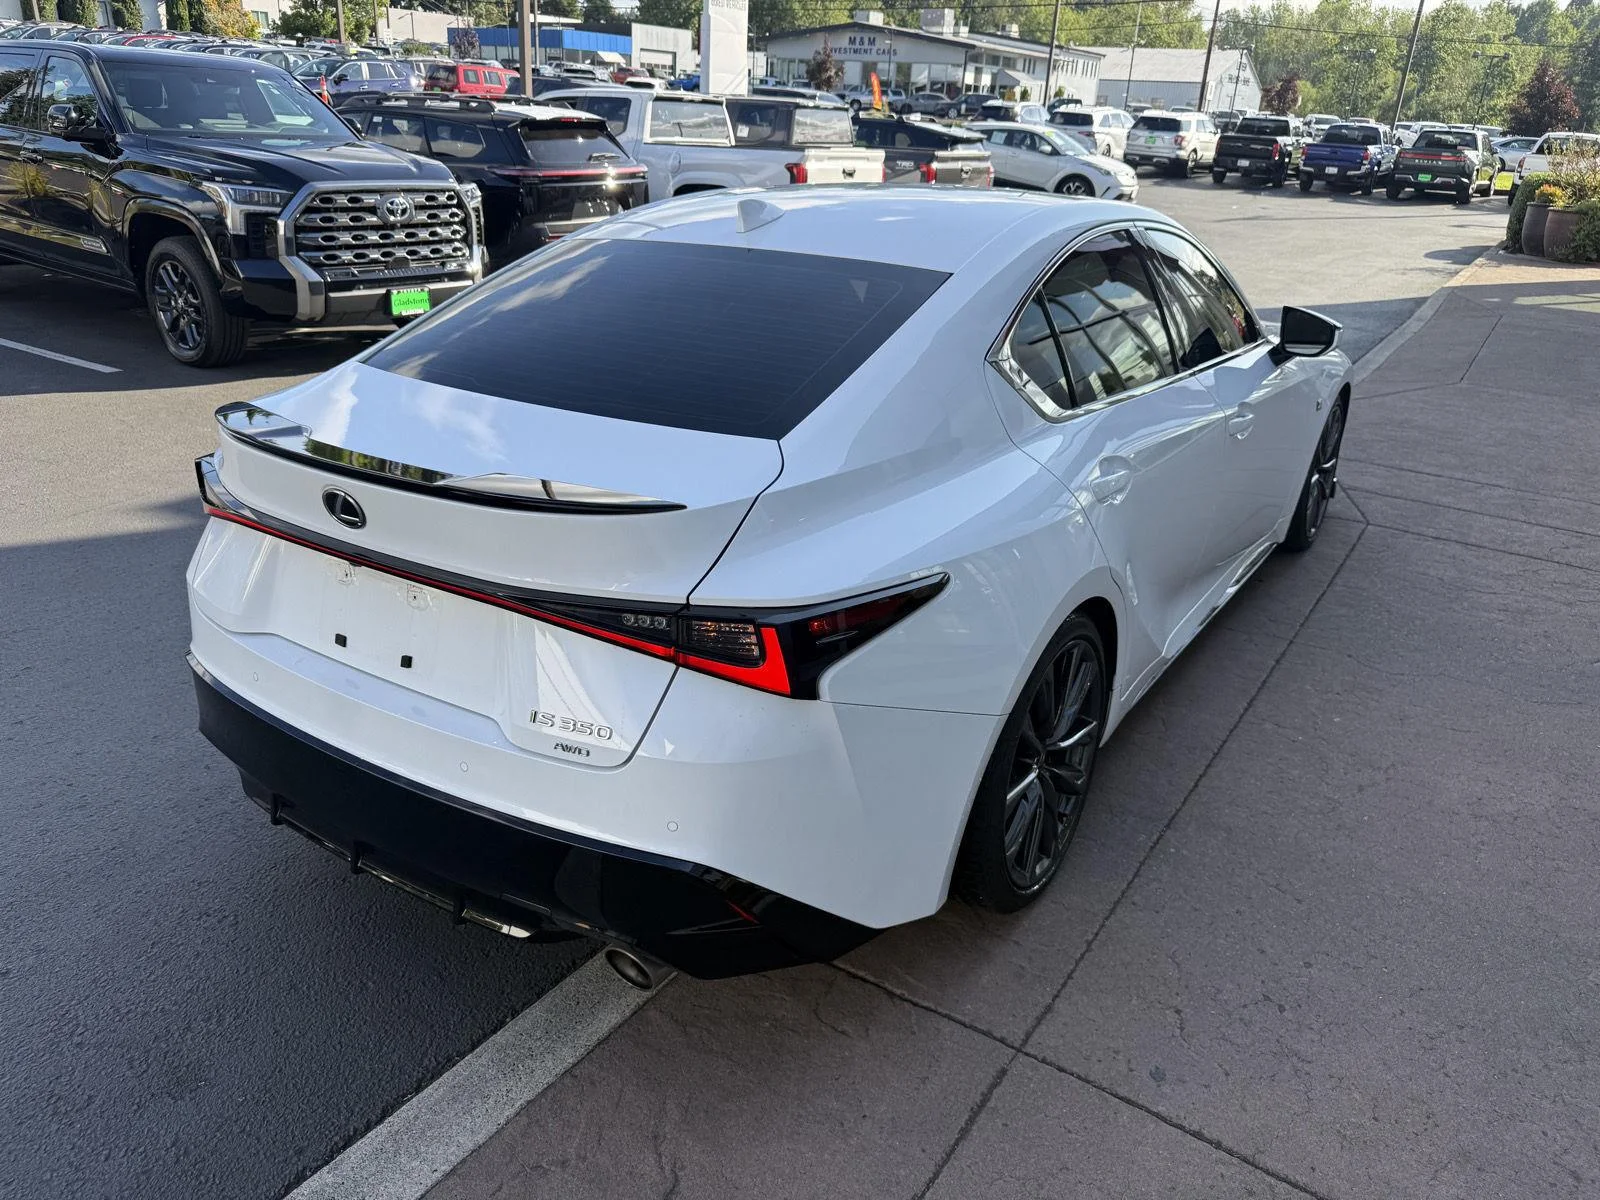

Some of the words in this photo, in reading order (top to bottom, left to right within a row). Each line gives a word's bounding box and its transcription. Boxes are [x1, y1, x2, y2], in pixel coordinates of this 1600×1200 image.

[848, 36, 857, 46] M
[858, 36, 865, 46] &
[867, 36, 876, 46] M
[829, 47, 872, 56] NVESTMENT
[530, 709, 555, 728] IS
[559, 716, 614, 741] 350
[554, 742, 590, 757] AWD
